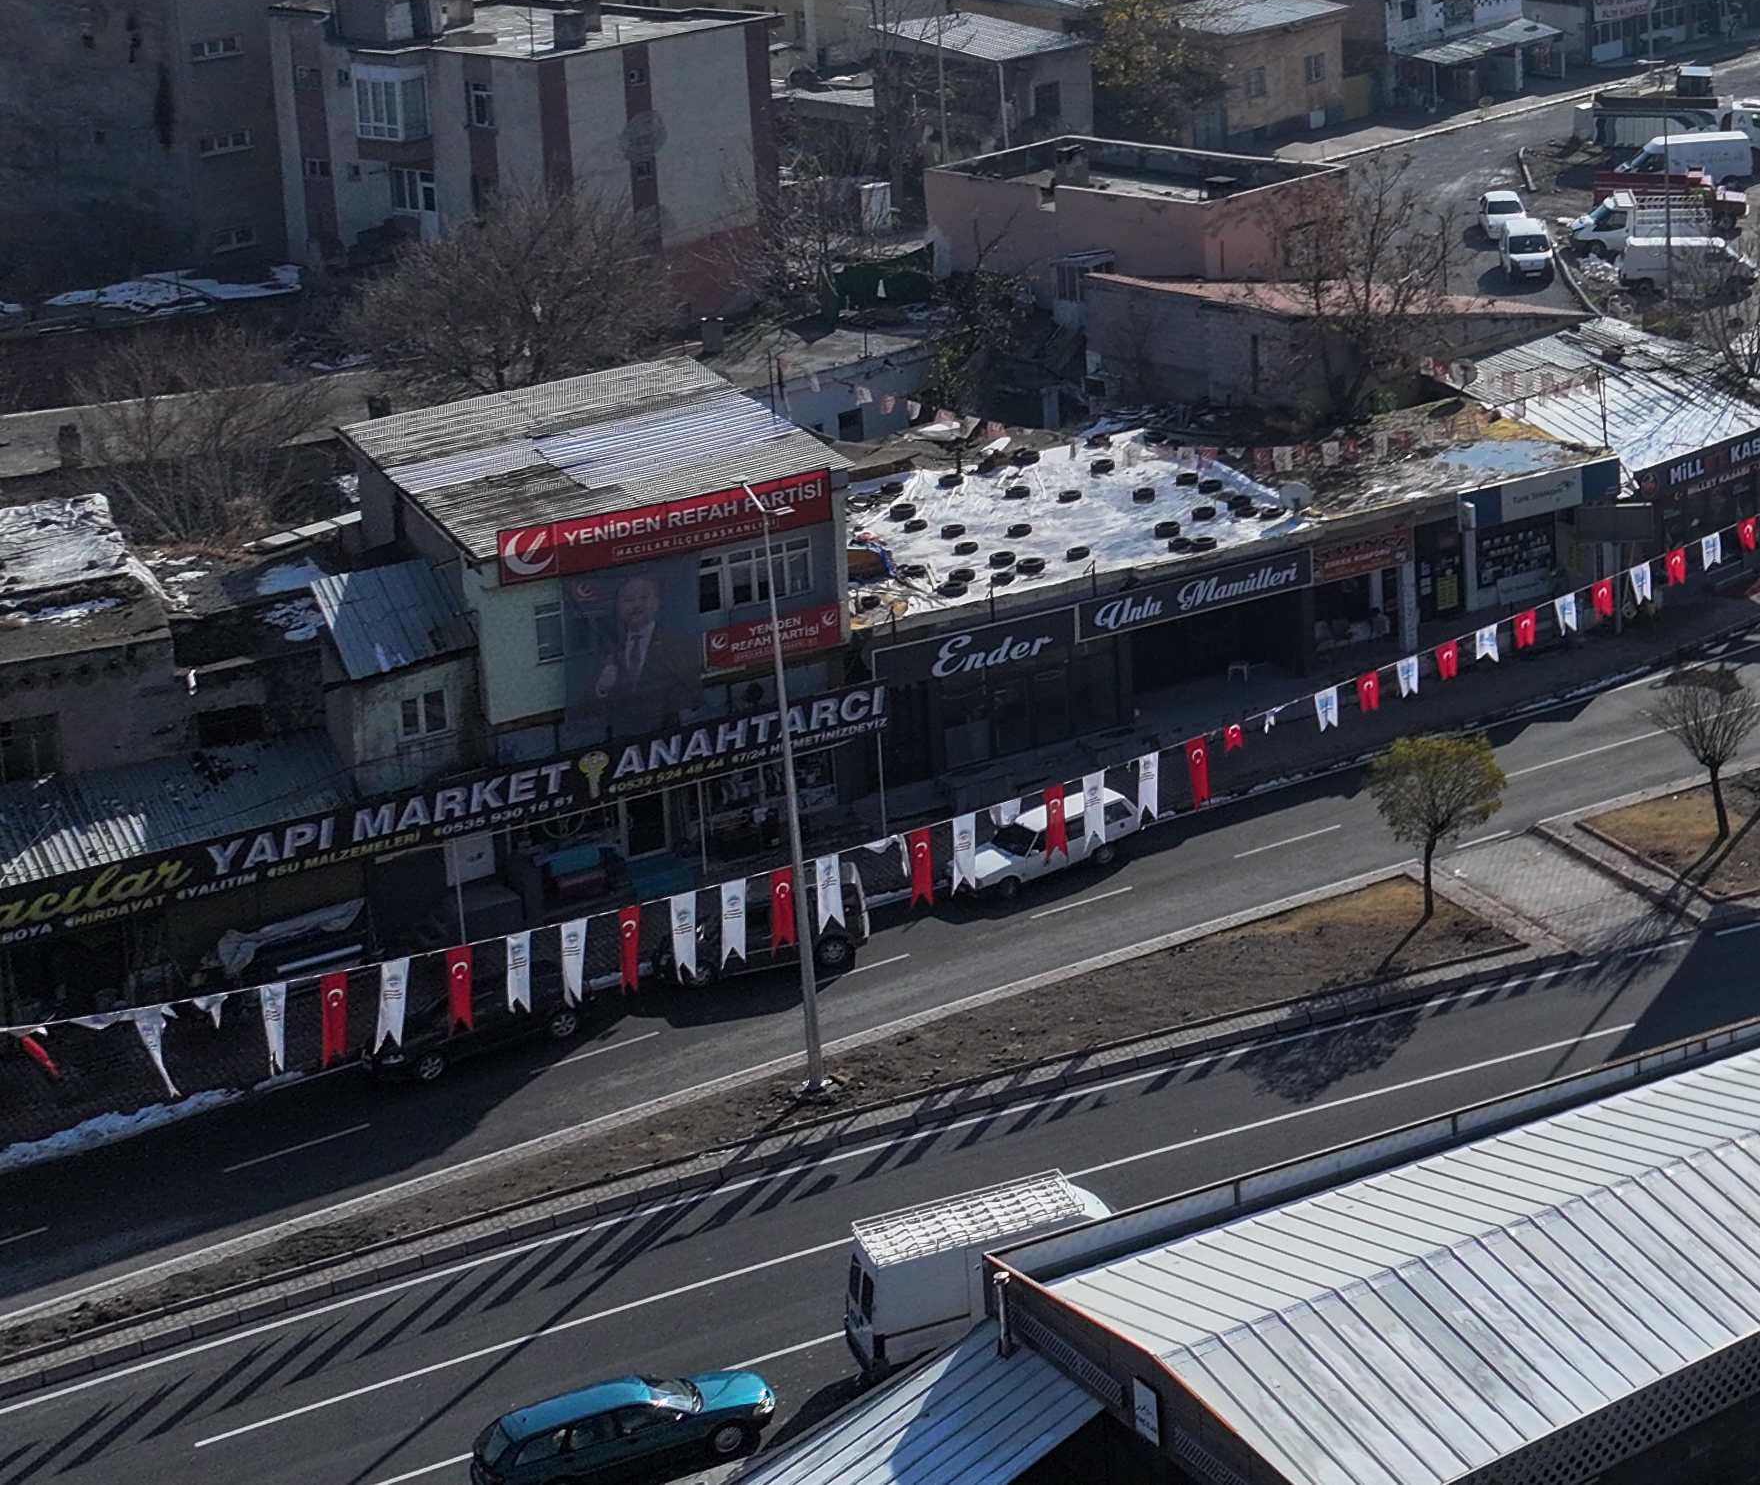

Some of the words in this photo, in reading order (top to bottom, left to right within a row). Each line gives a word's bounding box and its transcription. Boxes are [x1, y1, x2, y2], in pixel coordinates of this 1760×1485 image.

[564, 514, 662, 548] YENİDEN
[667, 499, 739, 528] REFAH
[744, 478, 823, 513] PARTİSİ
[616, 540, 670, 558] HACILAR
[704, 519, 777, 541] BAŞKANLII
[1093, 596, 1163, 630] Unlu
[1178, 561, 1298, 611] Mamülleri
[731, 635, 771, 653] REFAH
[749, 616, 802, 636] YENDEN
[931, 633, 1053, 678] Ender
[612, 685, 886, 779] ANAHTARCI
[770, 716, 889, 754] HMETİNİZDEYİZ
[206, 817, 335, 876] YAPI
[352, 760, 572, 842] MARKET
[442, 816, 485, 835] 0535
[491, 807, 523, 823] 930
[0, 859, 194, 929] acılar
[2, 923, 52, 945] BOYA
[74, 894, 167, 926] HIRDAVAT
[187, 871, 258, 898] YALITIM
[277, 861, 299, 877] SU
[303, 830, 421, 871] MALZEMELERİ
